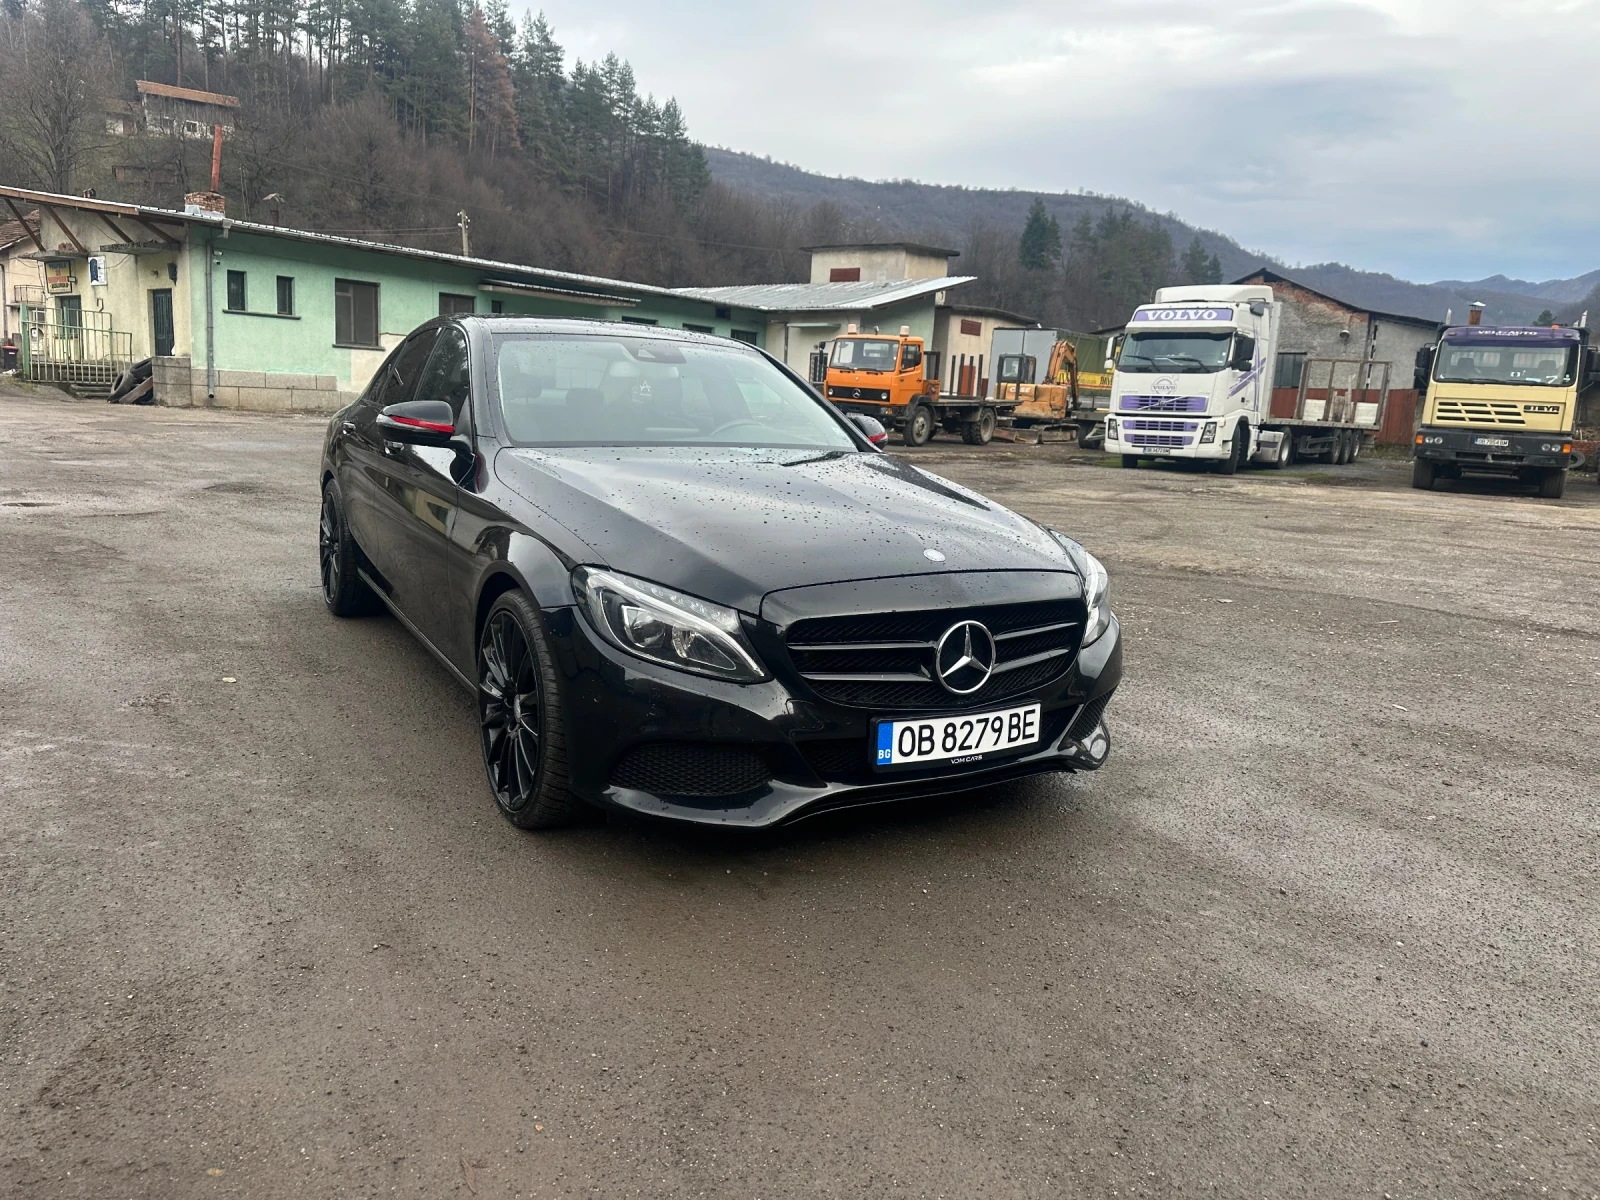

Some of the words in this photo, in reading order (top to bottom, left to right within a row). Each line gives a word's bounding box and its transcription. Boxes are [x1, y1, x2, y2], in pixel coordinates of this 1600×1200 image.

[1145, 310, 1218, 321] VOLVO
[898, 724, 935, 757] OB
[941, 715, 1004, 753] 8279
[1007, 708, 1036, 744] BE
[878, 749, 891, 760] BG
[966, 754, 983, 763] CARS
